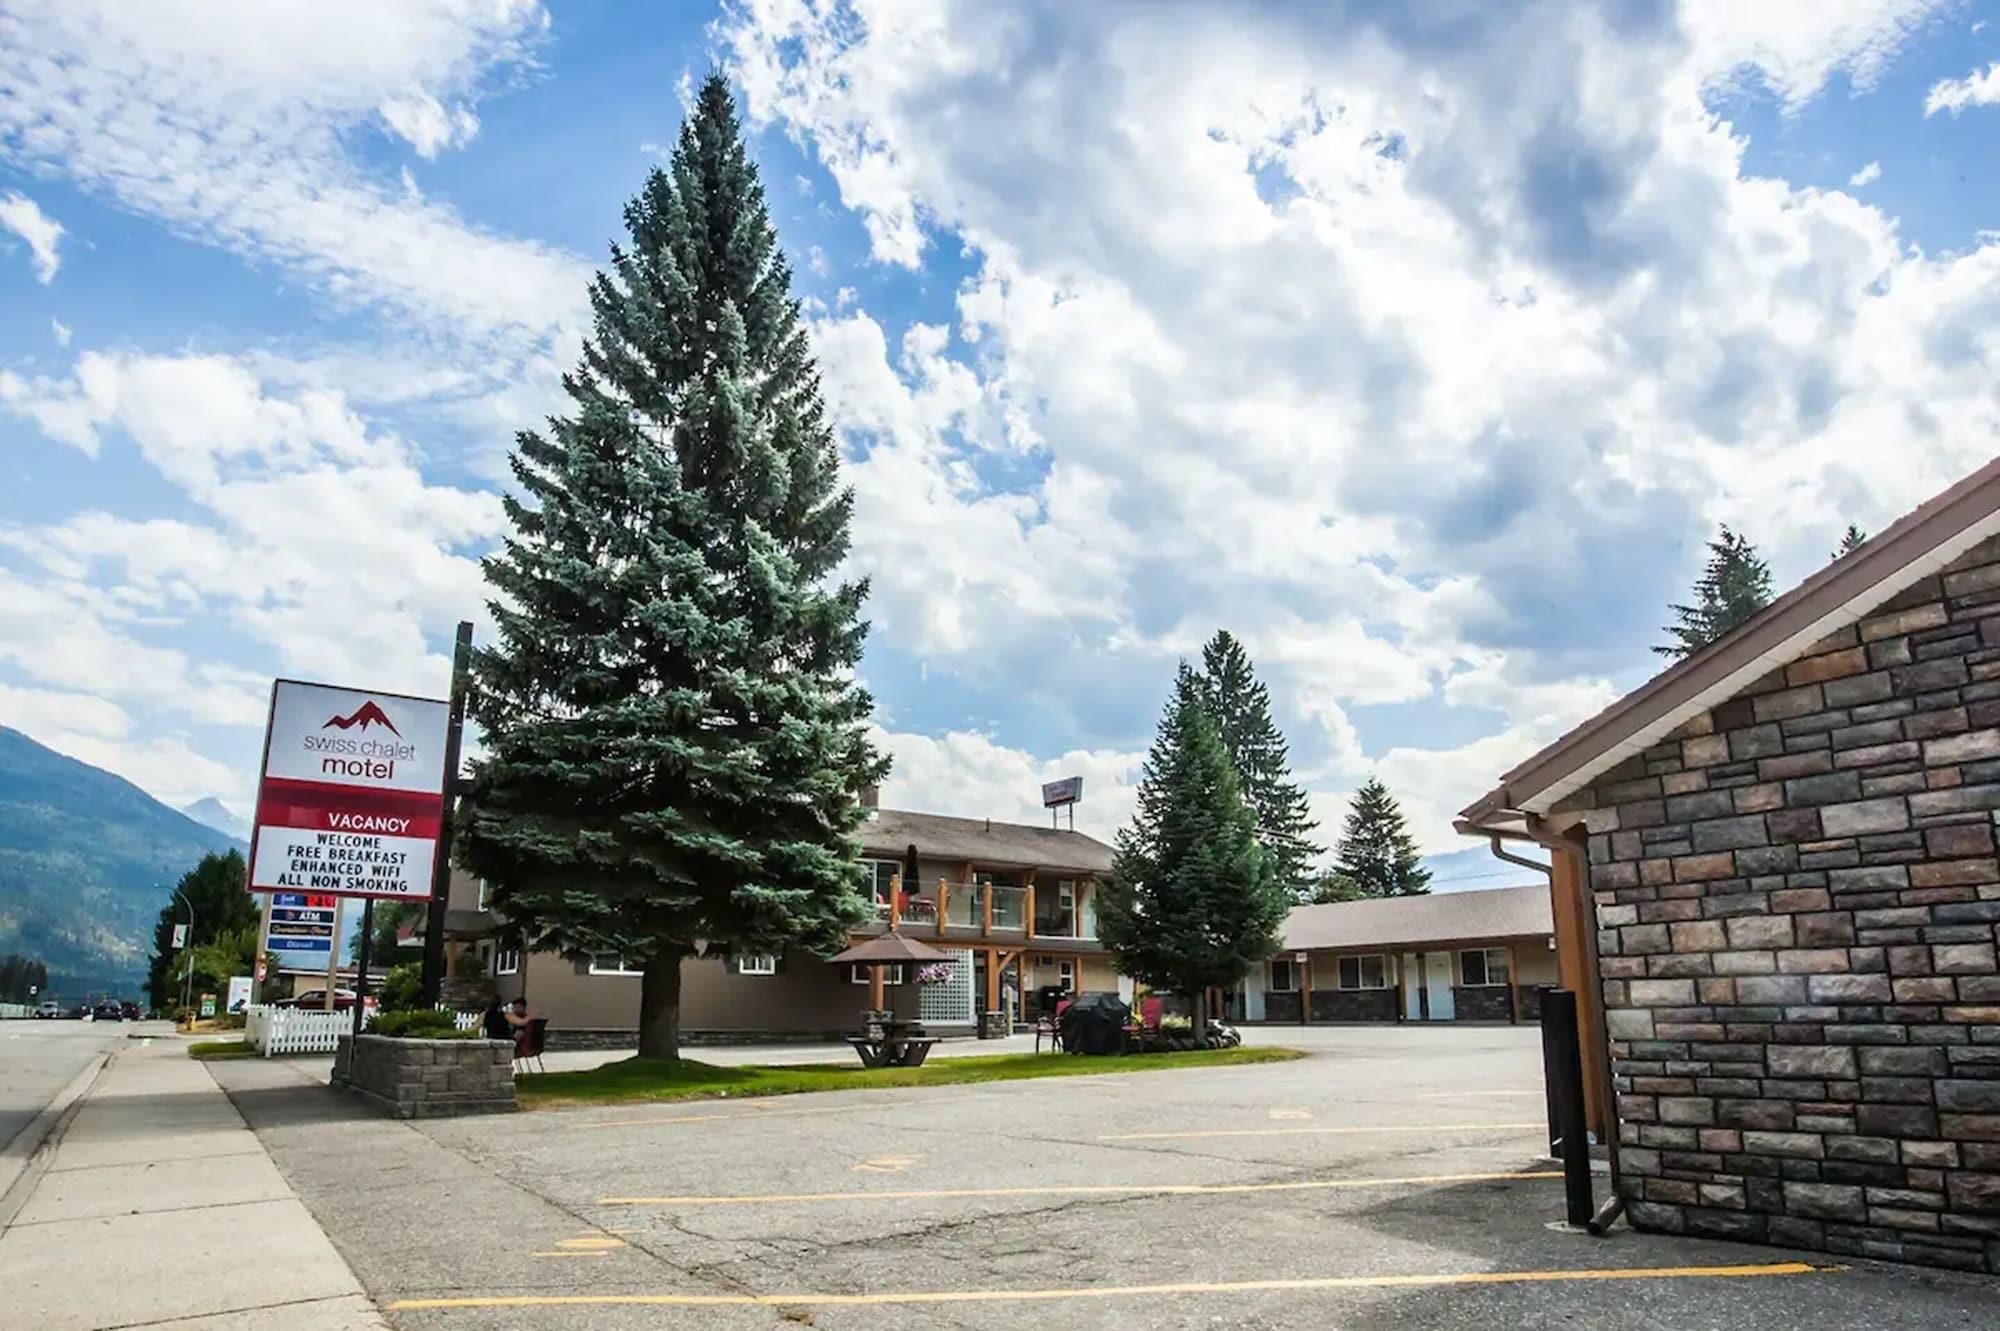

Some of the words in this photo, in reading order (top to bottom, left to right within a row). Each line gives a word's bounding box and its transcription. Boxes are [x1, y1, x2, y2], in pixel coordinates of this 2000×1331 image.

[304, 735, 357, 754] swiss
[360, 740, 417, 762] chalet
[322, 758, 394, 780] motel
[329, 813, 410, 832] VACANCY
[317, 834, 381, 849] WELCOME
[288, 845, 321, 859] FREE
[329, 848, 407, 864] BREAKFAST
[290, 860, 363, 875] ENHANCED
[371, 865, 401, 878] WIFI
[277, 873, 304, 886] ALL
[311, 875, 341, 888] NON
[346, 877, 408, 892] SMOKING
[298, 911, 321, 921] ATM
